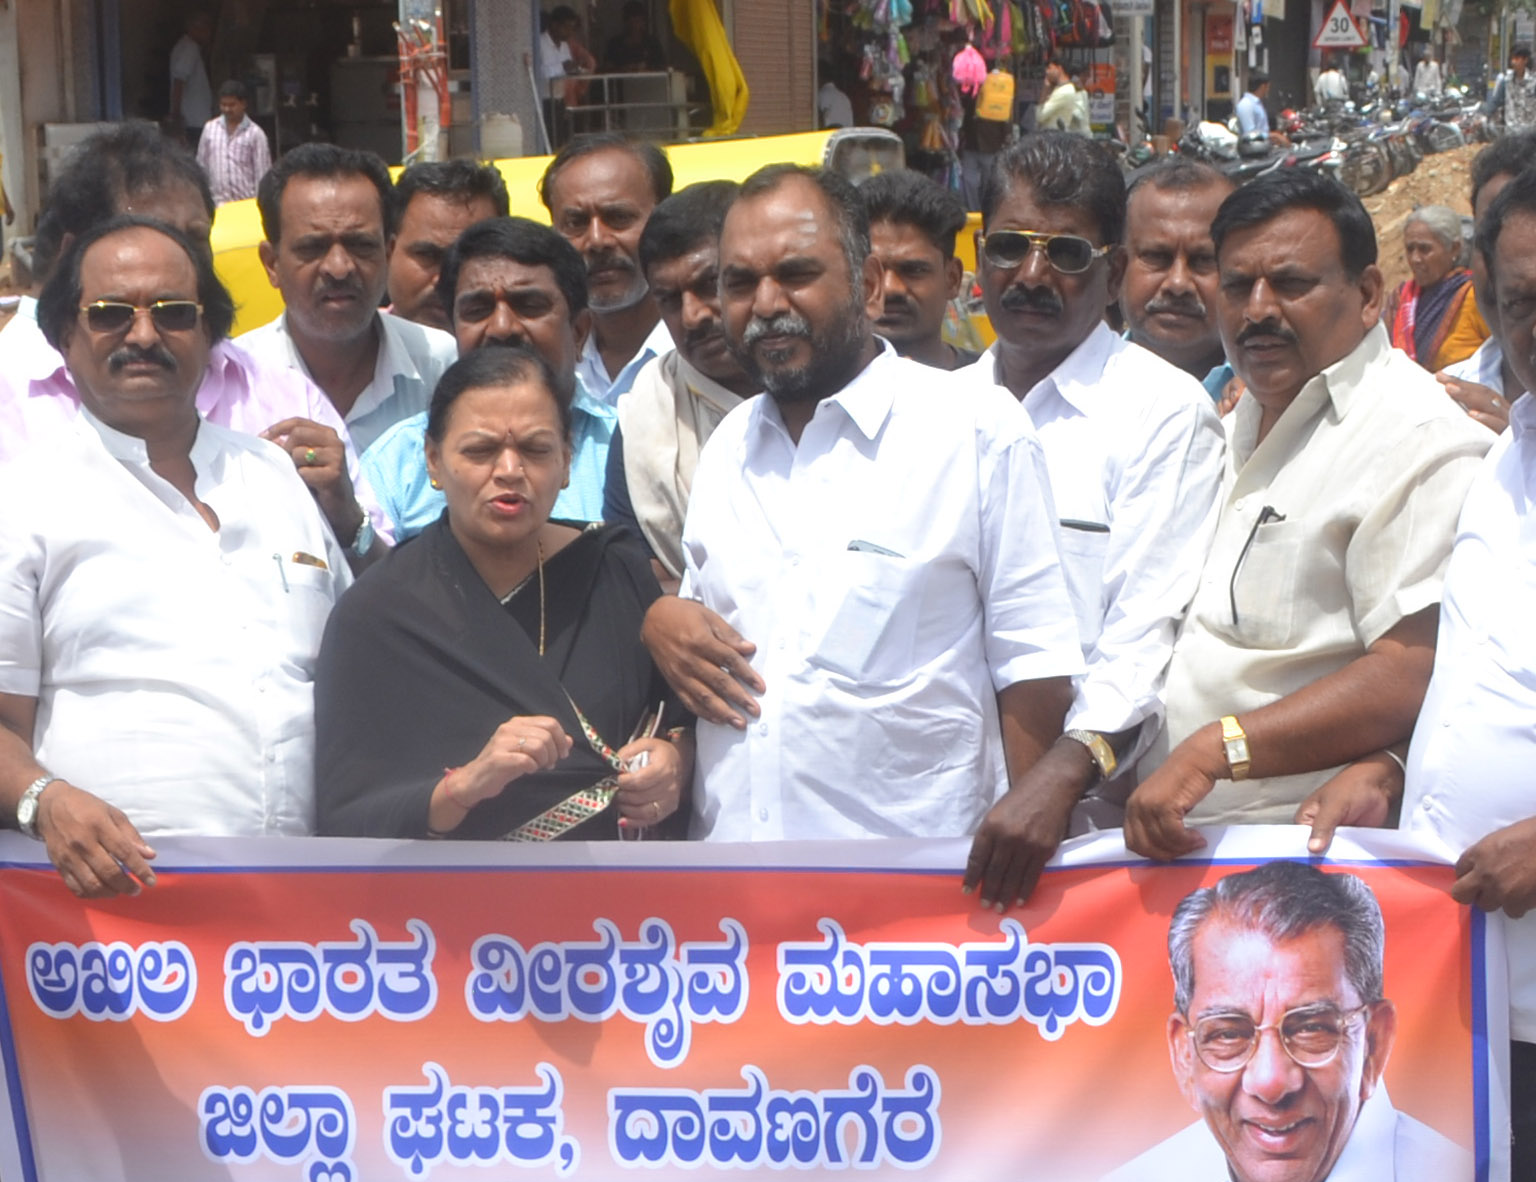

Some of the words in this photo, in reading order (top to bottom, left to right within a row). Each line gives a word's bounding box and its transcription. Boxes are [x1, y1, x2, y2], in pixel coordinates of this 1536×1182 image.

[1330, 17, 1349, 33] 30
[32, 940, 190, 1015] ಅಖಿಲ
[230, 925, 431, 1030] ಭಾರತ
[475, 924, 742, 1061] ವೀರಶೈವ
[783, 924, 1116, 1034] ಮಹಾಸಭಾ
[389, 1068, 574, 1171] ಘಟಕ,
[613, 1070, 935, 1164] ದಾವಣಗೆರೆ
